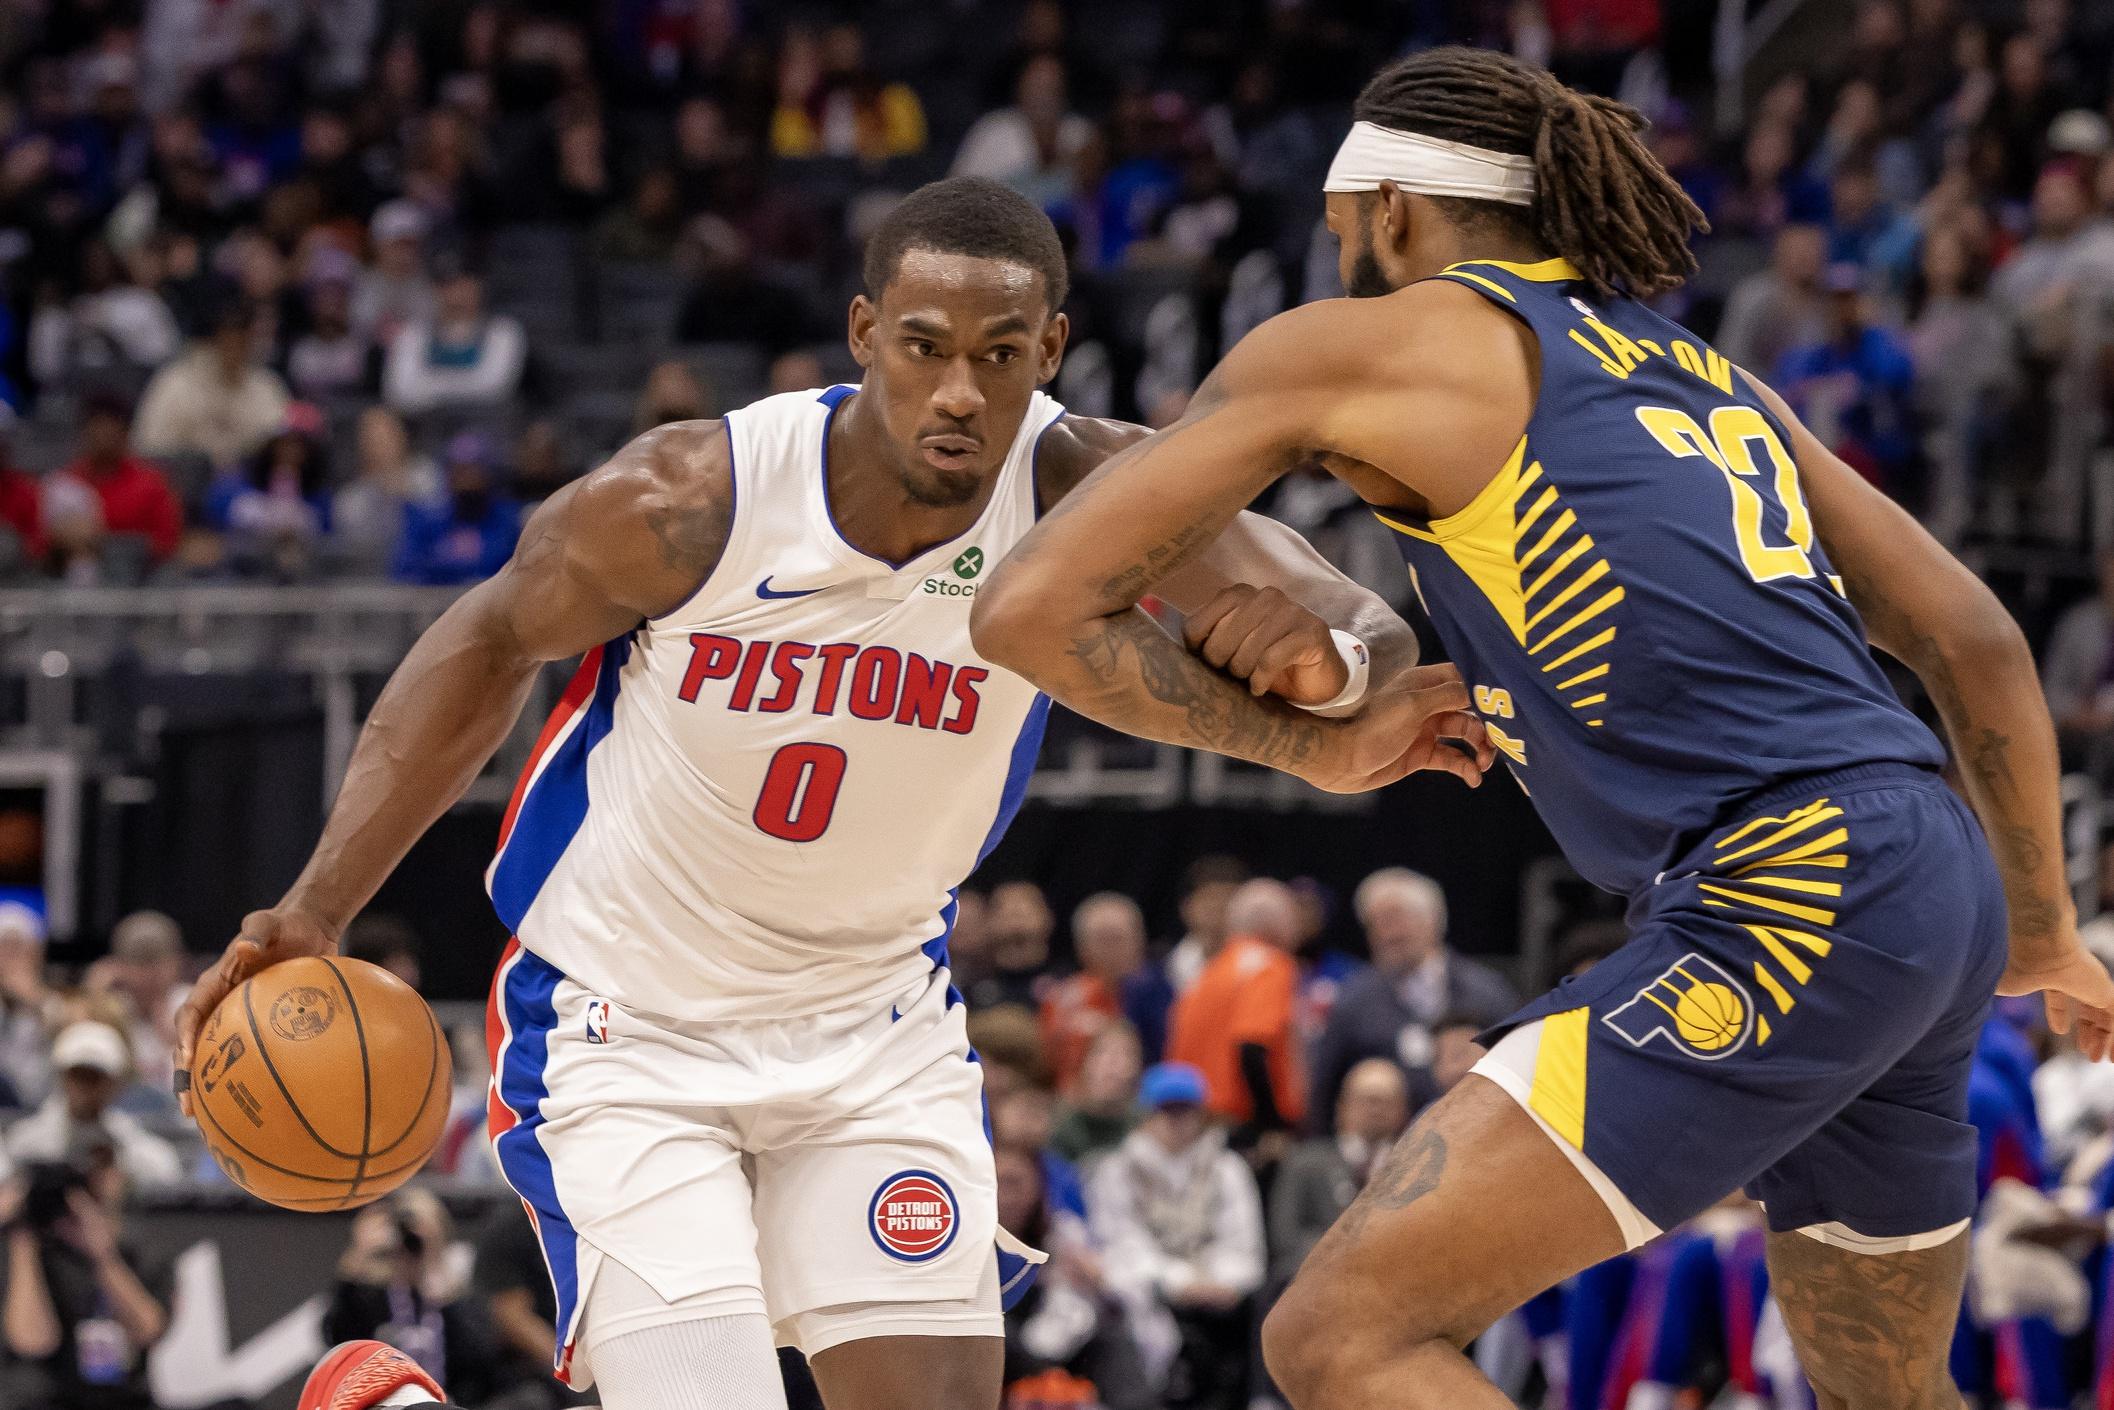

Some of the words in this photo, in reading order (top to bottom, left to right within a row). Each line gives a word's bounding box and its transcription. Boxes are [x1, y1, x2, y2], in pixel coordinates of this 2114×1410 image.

[678, 632, 990, 735] PISTONS
[752, 741, 848, 843] 0
[886, 1201, 942, 1216] DETROIT
[886, 1216, 943, 1231] PISTONS
